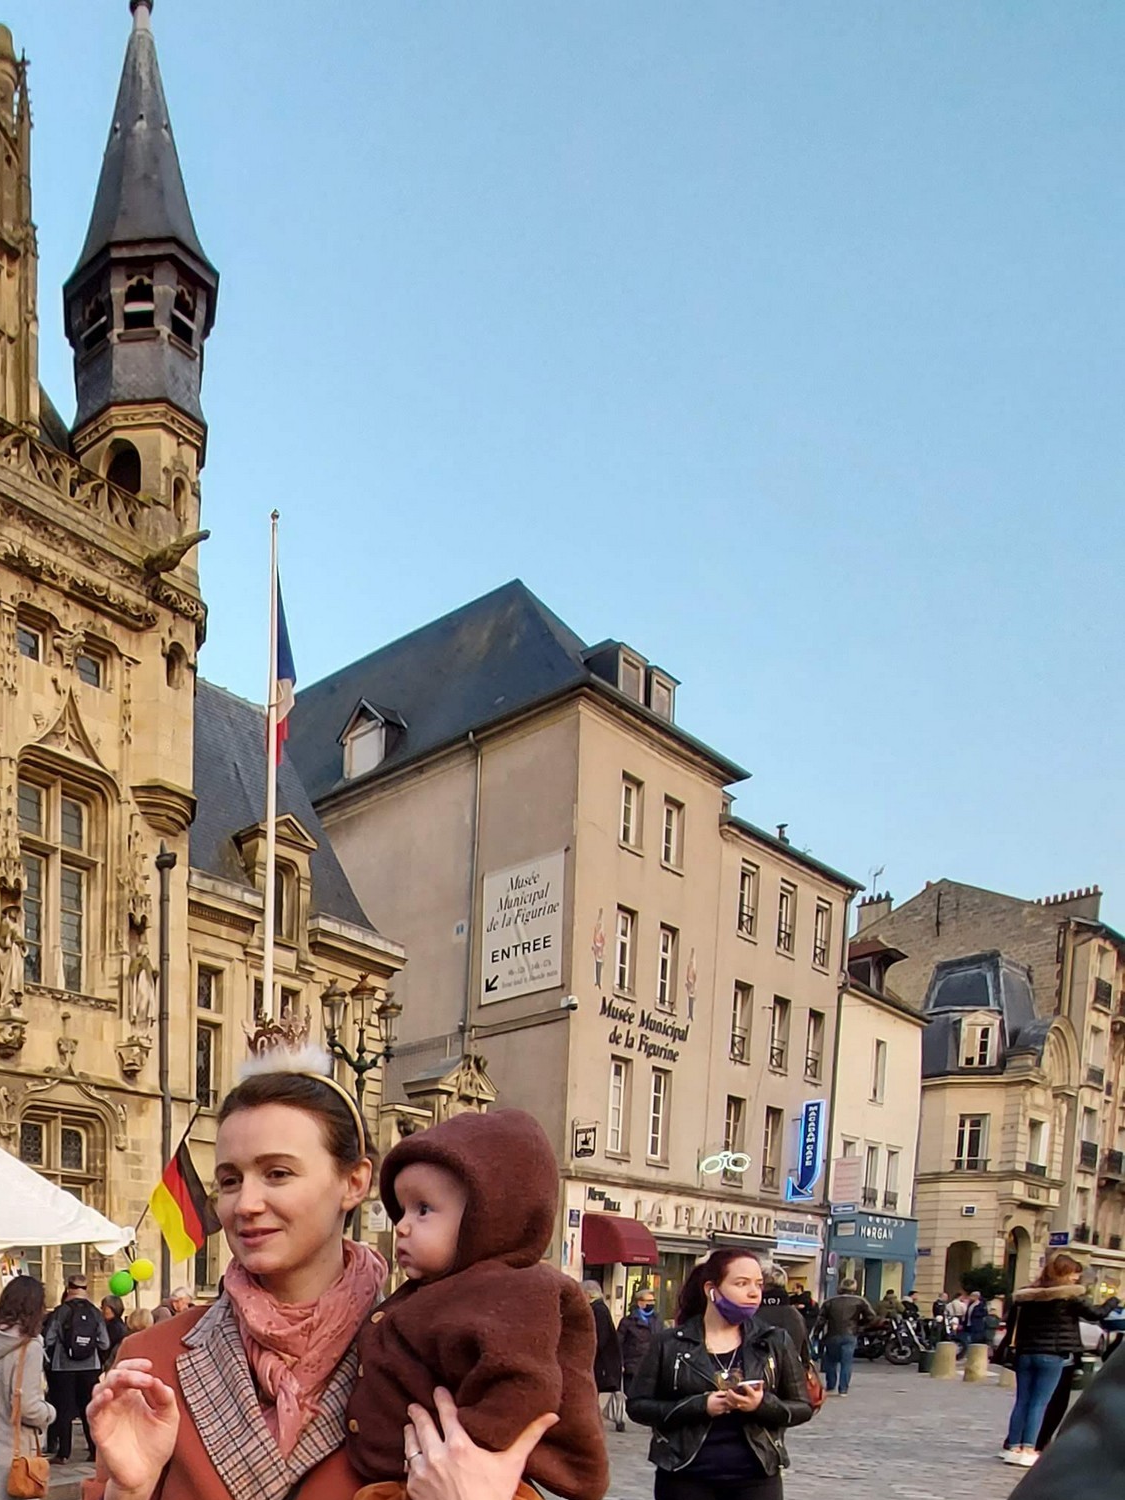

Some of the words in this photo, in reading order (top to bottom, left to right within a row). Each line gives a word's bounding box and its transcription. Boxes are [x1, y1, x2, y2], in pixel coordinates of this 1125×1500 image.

[497, 882, 550, 912] Municipal
[507, 872, 540, 892] Musée
[486, 917, 499, 933] de
[501, 912, 512, 929] la
[514, 901, 560, 925] Figurine
[491, 934, 552, 963] ENTREE
[599, 996, 635, 1025] Musée
[638, 1009, 690, 1043] Municipal
[608, 1025, 623, 1045] de
[624, 1029, 635, 1049] la
[637, 1033, 680, 1063] Figurine
[860, 1225, 893, 1240] MORGAN
